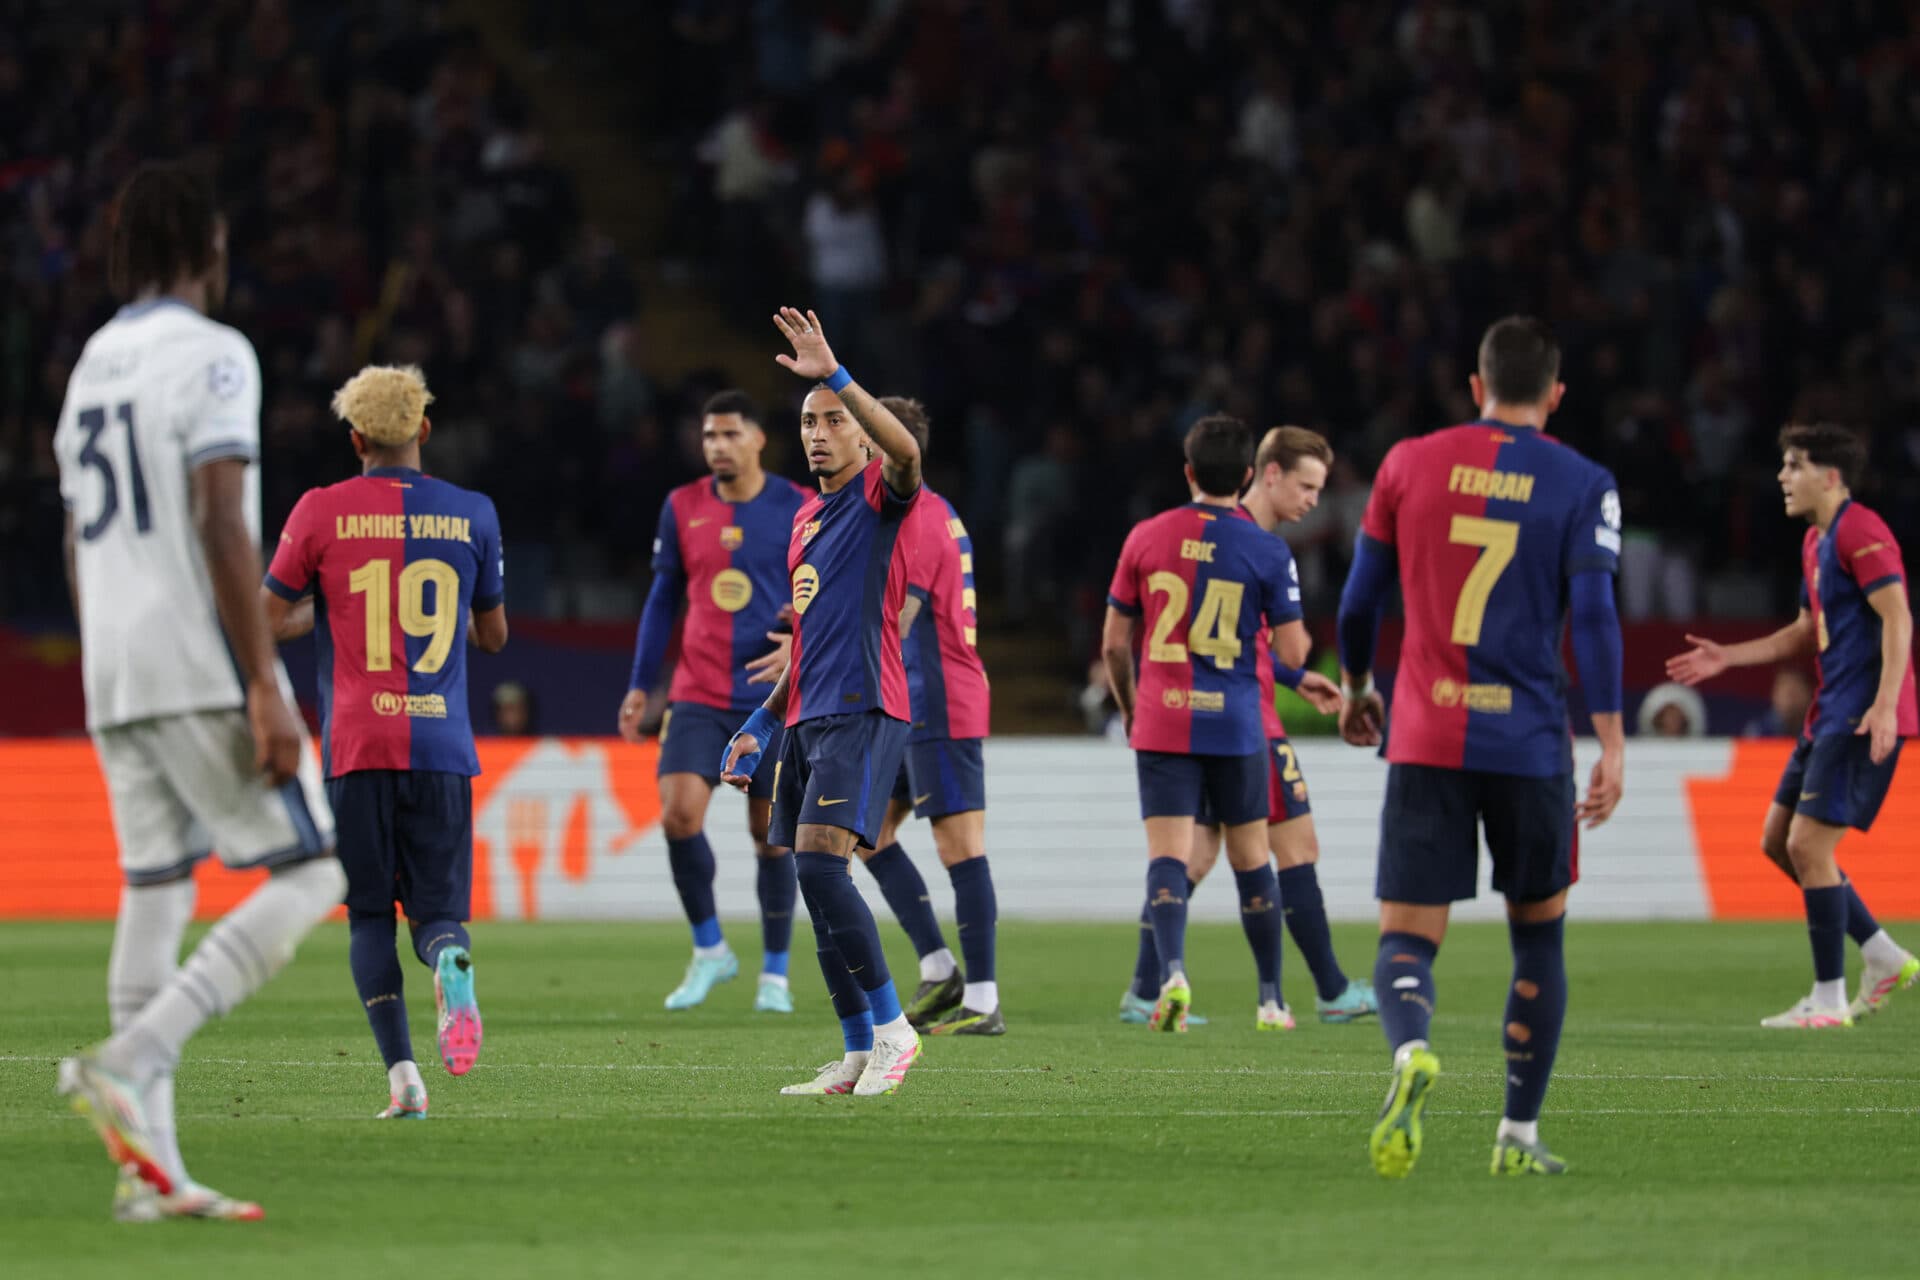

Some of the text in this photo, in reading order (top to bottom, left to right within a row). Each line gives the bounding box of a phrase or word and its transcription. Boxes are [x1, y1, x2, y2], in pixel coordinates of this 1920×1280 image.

[78, 402, 153, 541] 31
[1449, 464, 1535, 503] FERRAN
[336, 513, 472, 543] LAMINE YAMAL
[1180, 538, 1217, 563] ERIC
[349, 558, 460, 674] 19
[1147, 570, 1245, 670] 24
[1449, 514, 1520, 646] 7
